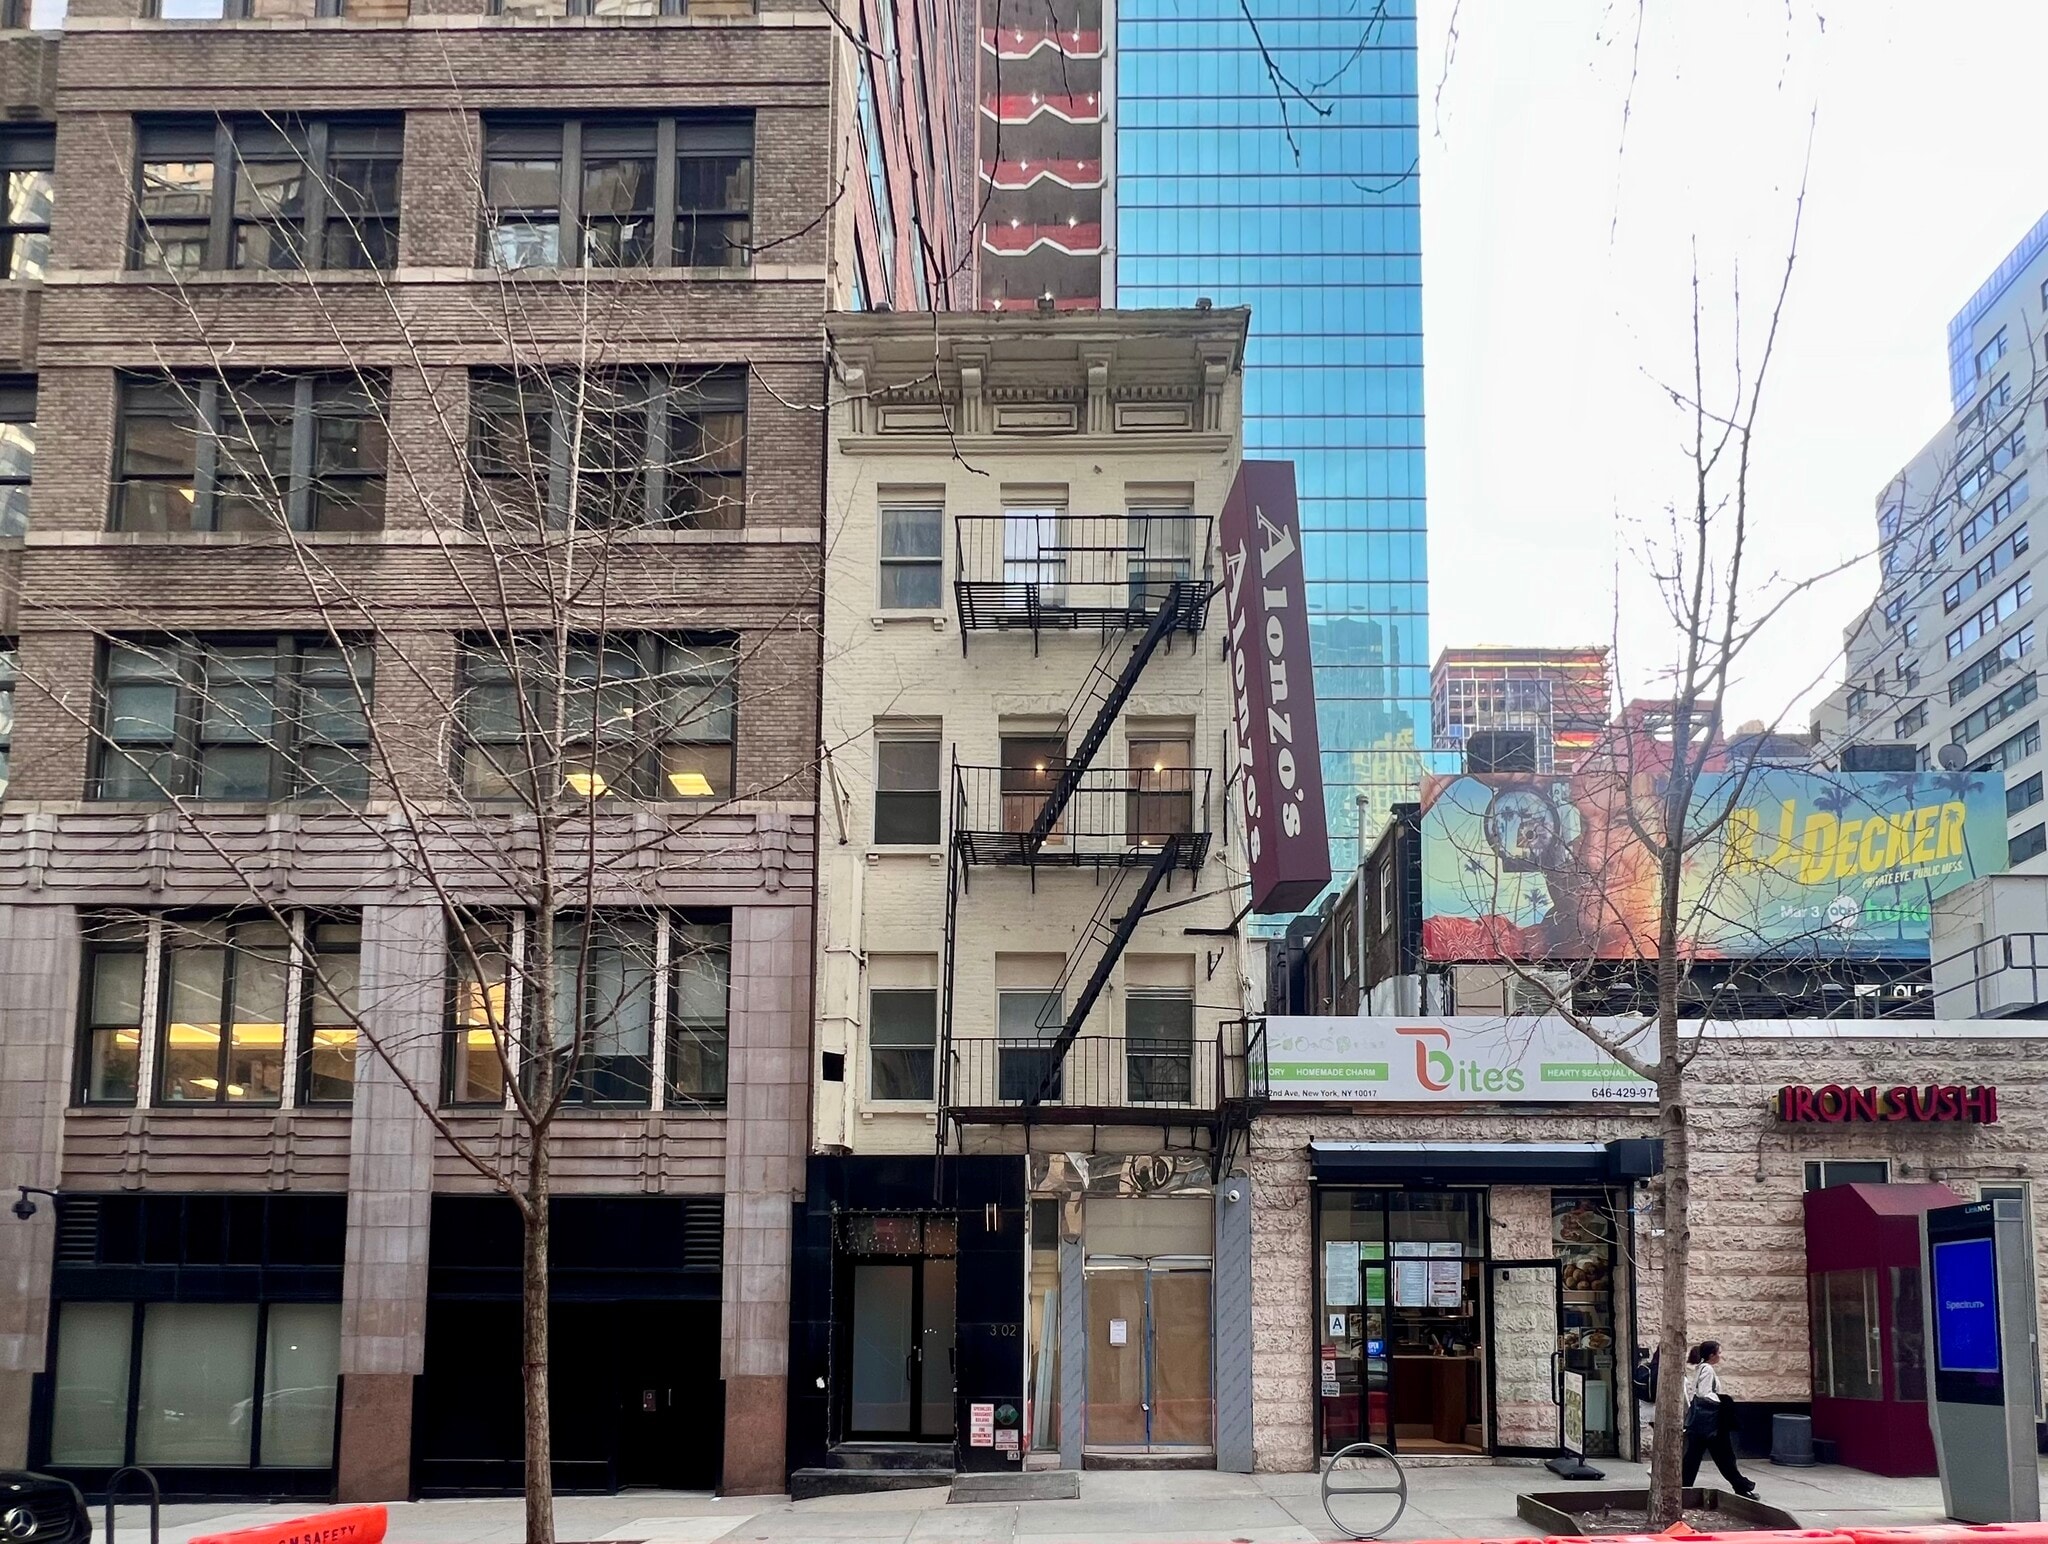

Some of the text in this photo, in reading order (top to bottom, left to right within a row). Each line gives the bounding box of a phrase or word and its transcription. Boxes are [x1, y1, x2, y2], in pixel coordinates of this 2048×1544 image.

[1255, 504, 1304, 839] Alonzo's
[1225, 538, 1262, 865] Alonzo's
[1799, 800, 1966, 886] DECKER
[1862, 872, 1893, 889] PRIVATE
[1912, 864, 1940, 880] PUBLIC
[1780, 904, 1820, 919] Mar 3
[1865, 898, 1929, 922] hulu
[1394, 1027, 1525, 1093] Bites
[1296, 1068, 1344, 1077] HOMEMADE
[1345, 1068, 1376, 1077] CHARM
[1547, 1069, 1580, 1077] HEARTY
[1581, 1069, 1627, 1077] SEASONAL
[1302, 1089, 1319, 1097] New
[1320, 1089, 1339, 1098] York,
[1341, 1089, 1352, 1097] NY
[1354, 1089, 1377, 1097] 10017
[1782, 1084, 1998, 1124] IRON SUSHI
[1945, 1300, 1982, 1312] Spectrum
[990, 1324, 1017, 1337] 302
[1332, 1317, 1343, 1330] A
[304, 1525, 356, 1544] SAFETY
